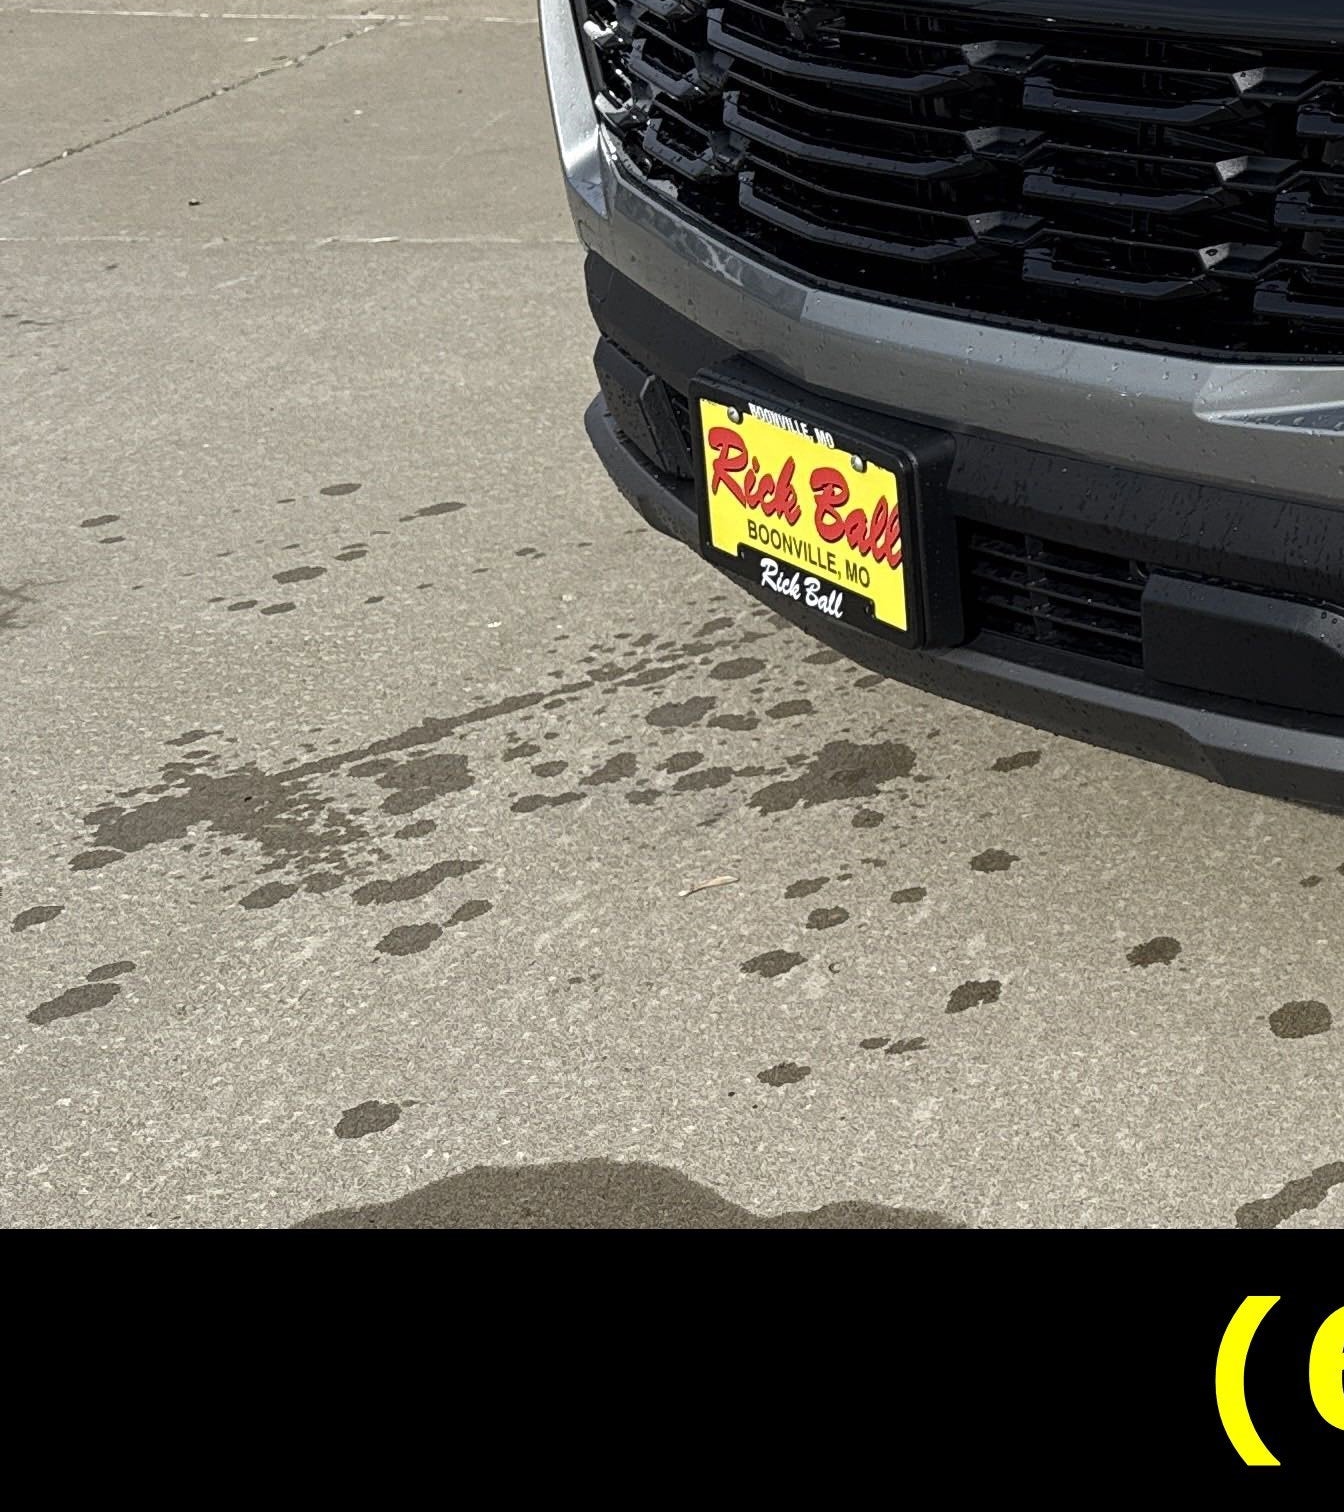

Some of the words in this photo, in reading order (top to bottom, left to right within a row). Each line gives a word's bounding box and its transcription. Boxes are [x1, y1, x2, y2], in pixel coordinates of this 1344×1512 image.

[813, 427, 836, 450] MO
[707, 426, 802, 527] Rick
[809, 466, 904, 571] Ball
[747, 518, 842, 581] BOONVILLE,
[844, 558, 871, 589] MO
[759, 556, 803, 602] Rick
[803, 576, 845, 620] Ball
